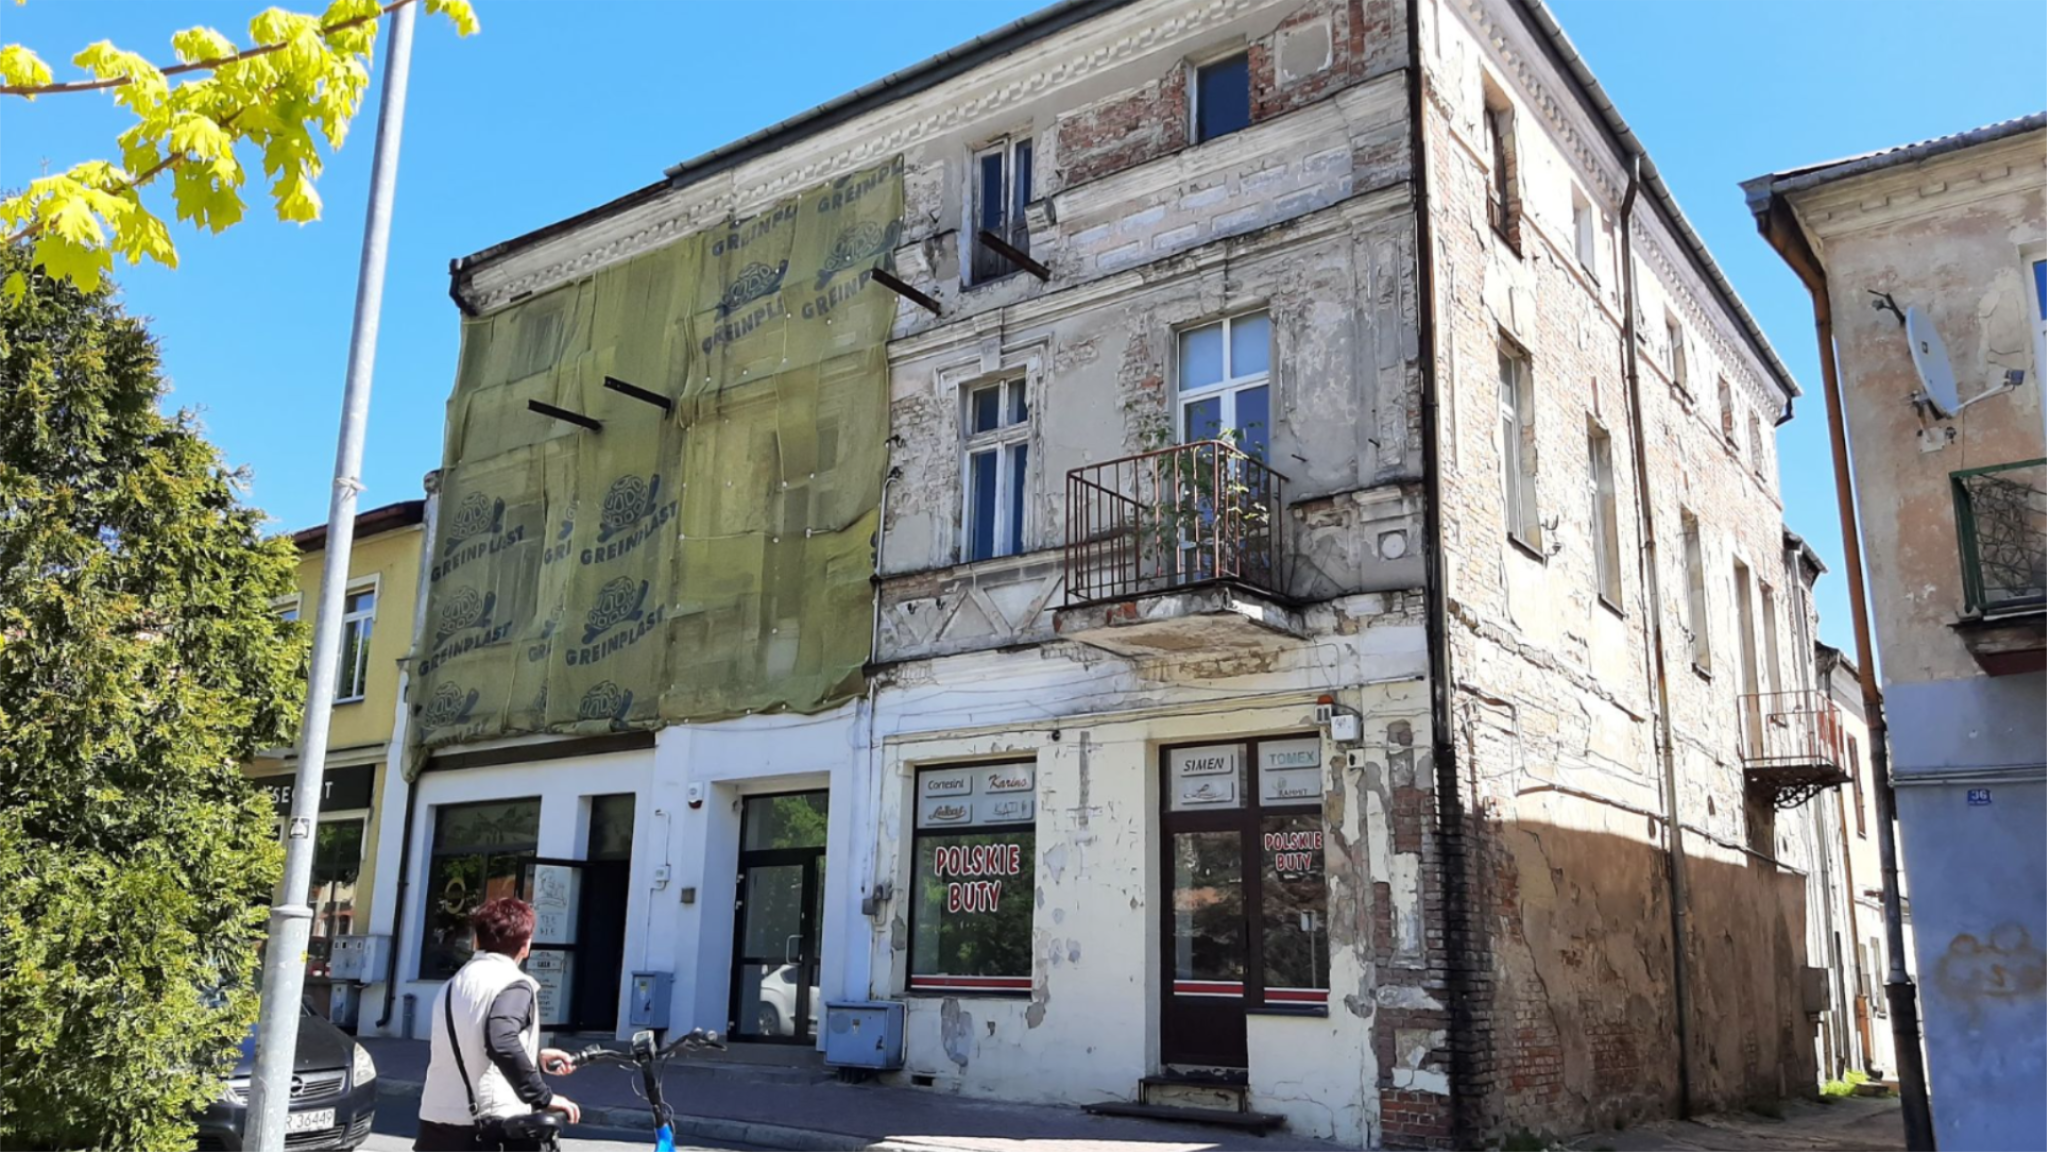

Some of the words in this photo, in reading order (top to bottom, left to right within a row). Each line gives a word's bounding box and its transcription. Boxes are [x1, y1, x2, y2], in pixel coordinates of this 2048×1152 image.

[430, 524, 524, 582] GREINPLAST
[565, 603, 665, 666] GREINPLAST
[418, 620, 513, 677] GREINPLAST
[1269, 751, 1315, 765] TOMEX
[1971, 790, 1988, 800] 36
[1264, 832, 1322, 851] POLSKIE
[934, 844, 1020, 876] POLSKIE
[1275, 853, 1312, 872] BUTY
[947, 881, 1002, 912] BUTY
[296, 1110, 333, 1128] 36449
